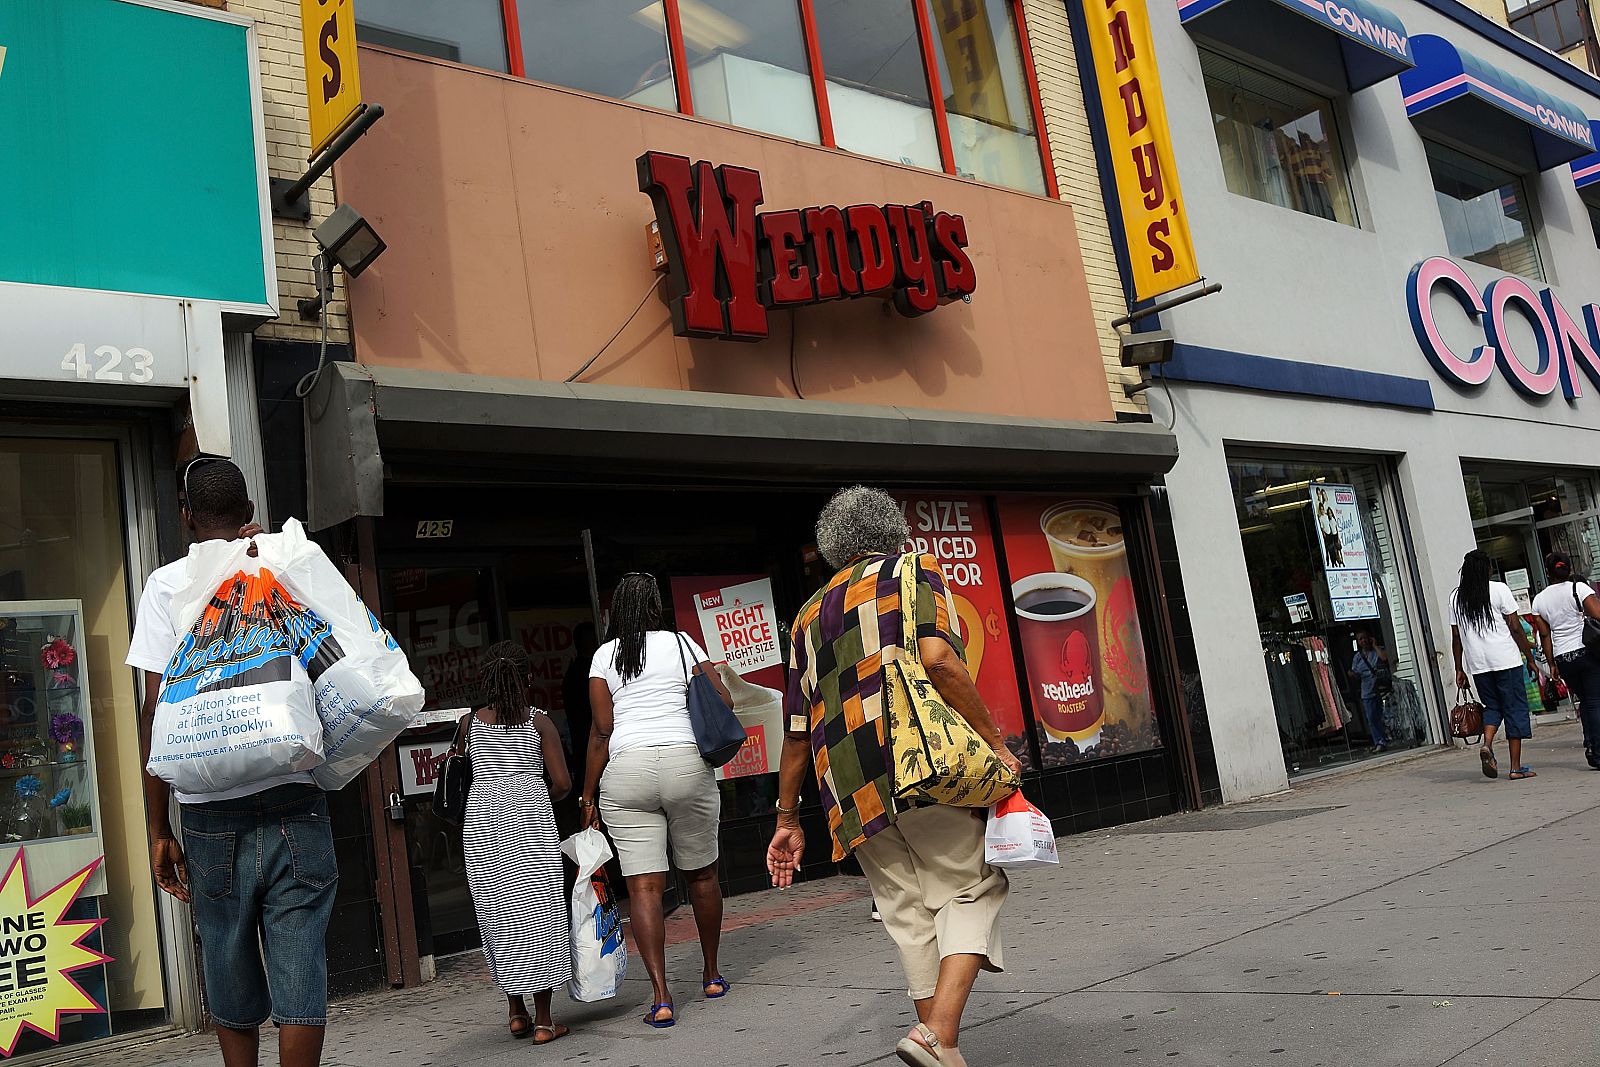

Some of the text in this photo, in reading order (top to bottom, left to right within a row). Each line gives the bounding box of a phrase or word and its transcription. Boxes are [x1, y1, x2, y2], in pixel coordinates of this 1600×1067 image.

[1324, 0, 1408, 57] CONWAY
[1535, 104, 1592, 145] CONWAY
[1106, 0, 1179, 275] ndy's
[1406, 256, 1600, 400] CON
[60, 342, 154, 383] 423
[915, 500, 973, 532] SIZE
[417, 520, 452, 538] 425
[932, 537, 977, 560] ICED
[941, 563, 983, 586] FOR
[702, 595, 720, 608] NEW
[715, 603, 764, 632] RIGHT
[720, 622, 772, 652] PRICE
[725, 640, 775, 662] RIGHT SIZE
[739, 655, 765, 668] MENU
[432, 665, 482, 691] PRIC
[1041, 675, 1095, 702] redhead
[226, 692, 262, 706] Street
[320, 692, 344, 718] Street
[1057, 700, 1086, 714] ROASTERS
[177, 719, 188, 730] at
[226, 706, 261, 721] Street
[326, 699, 359, 731] Brooklyn
[221, 718, 273, 737] Brooklyn
[742, 734, 760, 747] LITY
[162, 753, 184, 761] REUSE
[729, 761, 764, 776] CREAMY
[0, 911, 46, 935] NE
[4, 987, 47, 1000] OF GLASSES
[8, 997, 28, 1006] EXAM
[29, 994, 44, 1002] AND
